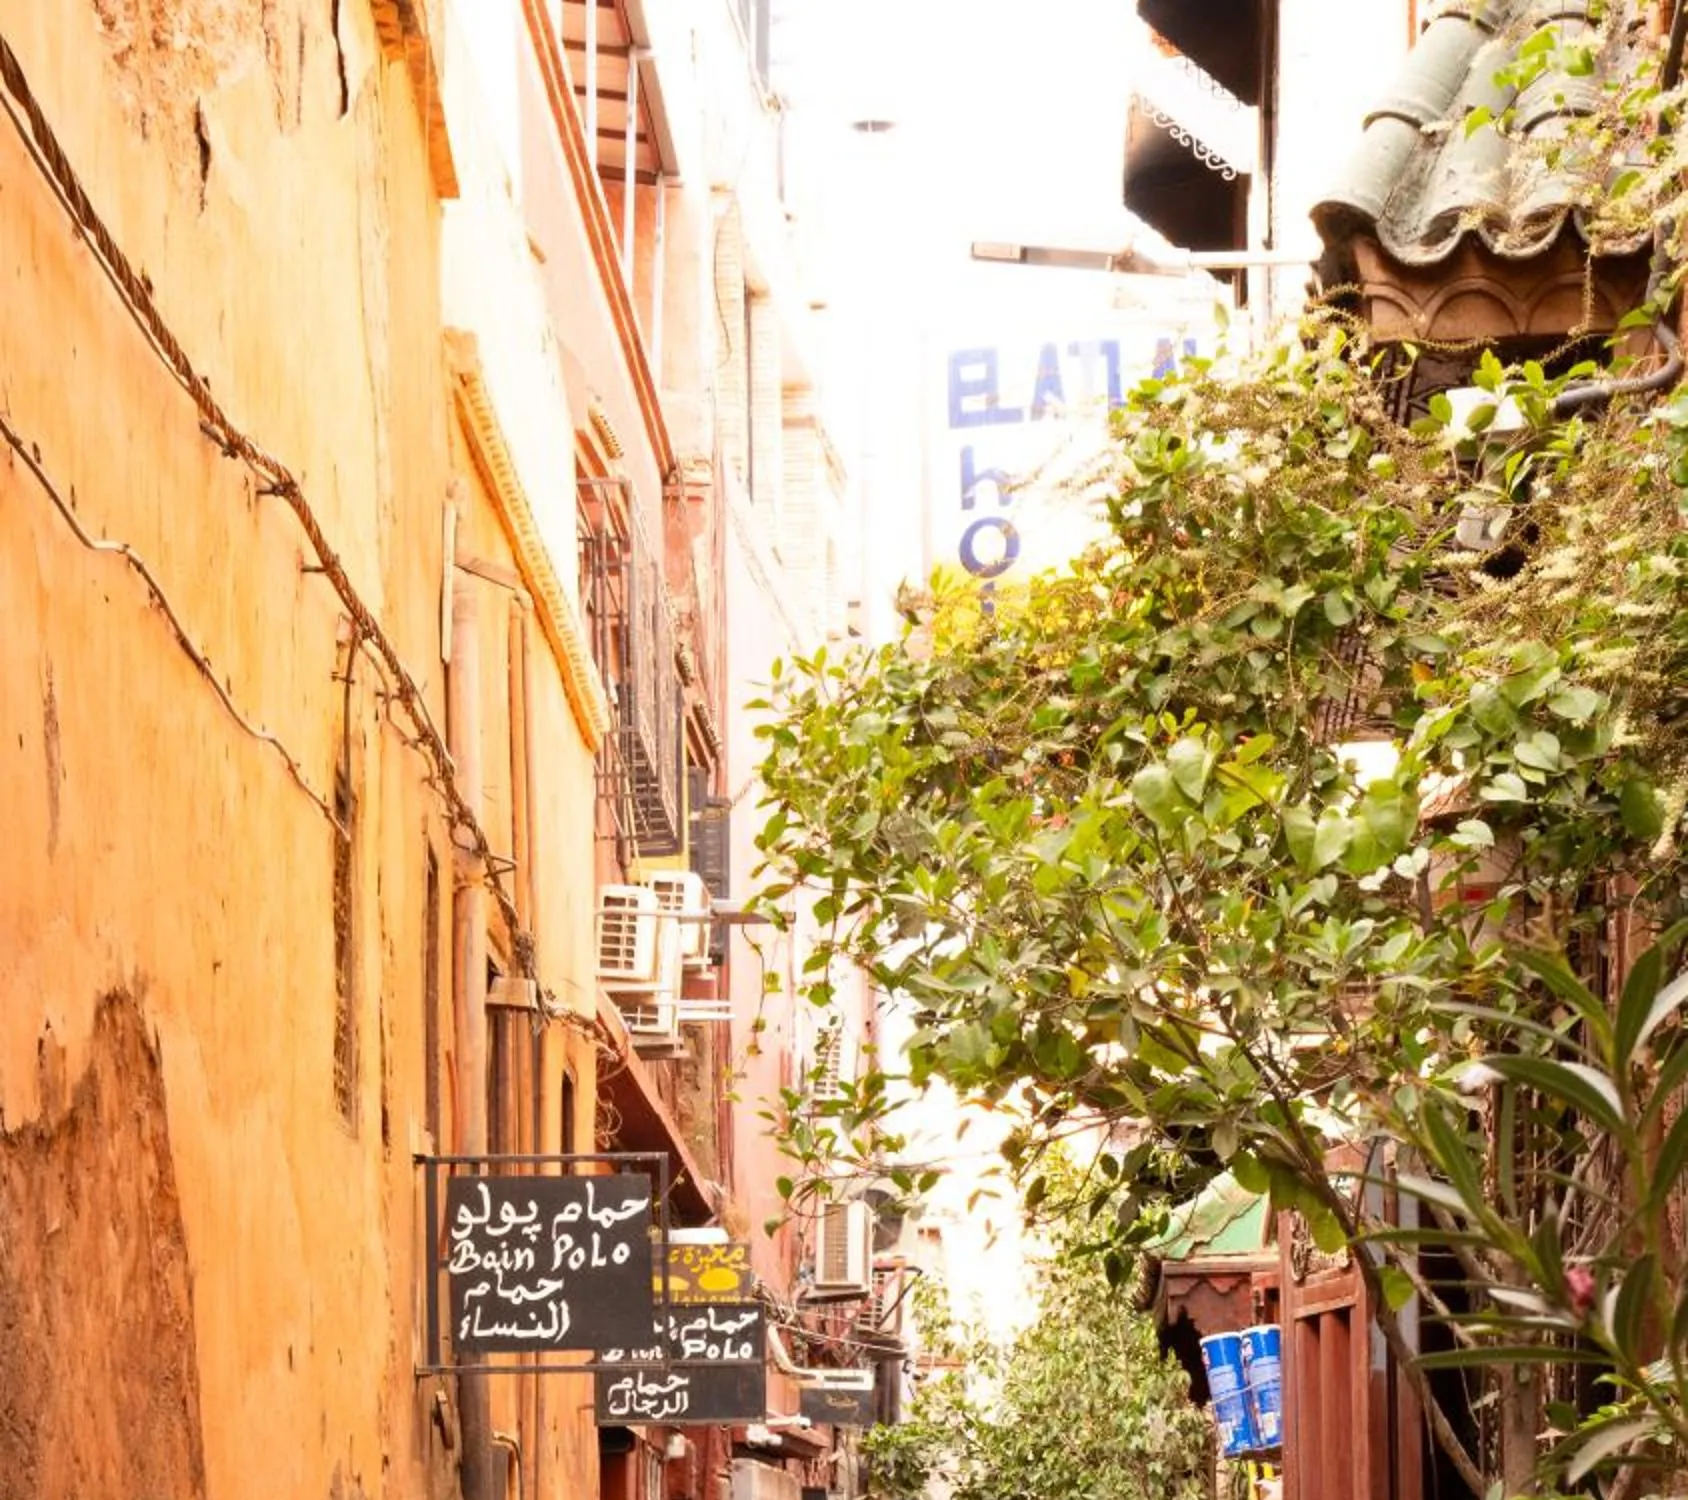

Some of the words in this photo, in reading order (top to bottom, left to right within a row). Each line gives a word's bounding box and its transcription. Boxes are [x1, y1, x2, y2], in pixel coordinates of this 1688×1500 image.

[551, 1180, 649, 1241] حمام
[449, 1239, 535, 1274] Bain
[463, 1267, 565, 1309] حمام
[459, 1300, 571, 1343] النساء
[680, 1306, 759, 1342] حمام
[608, 1371, 690, 1402] حمام
[608, 1390, 690, 1420] الرجال
